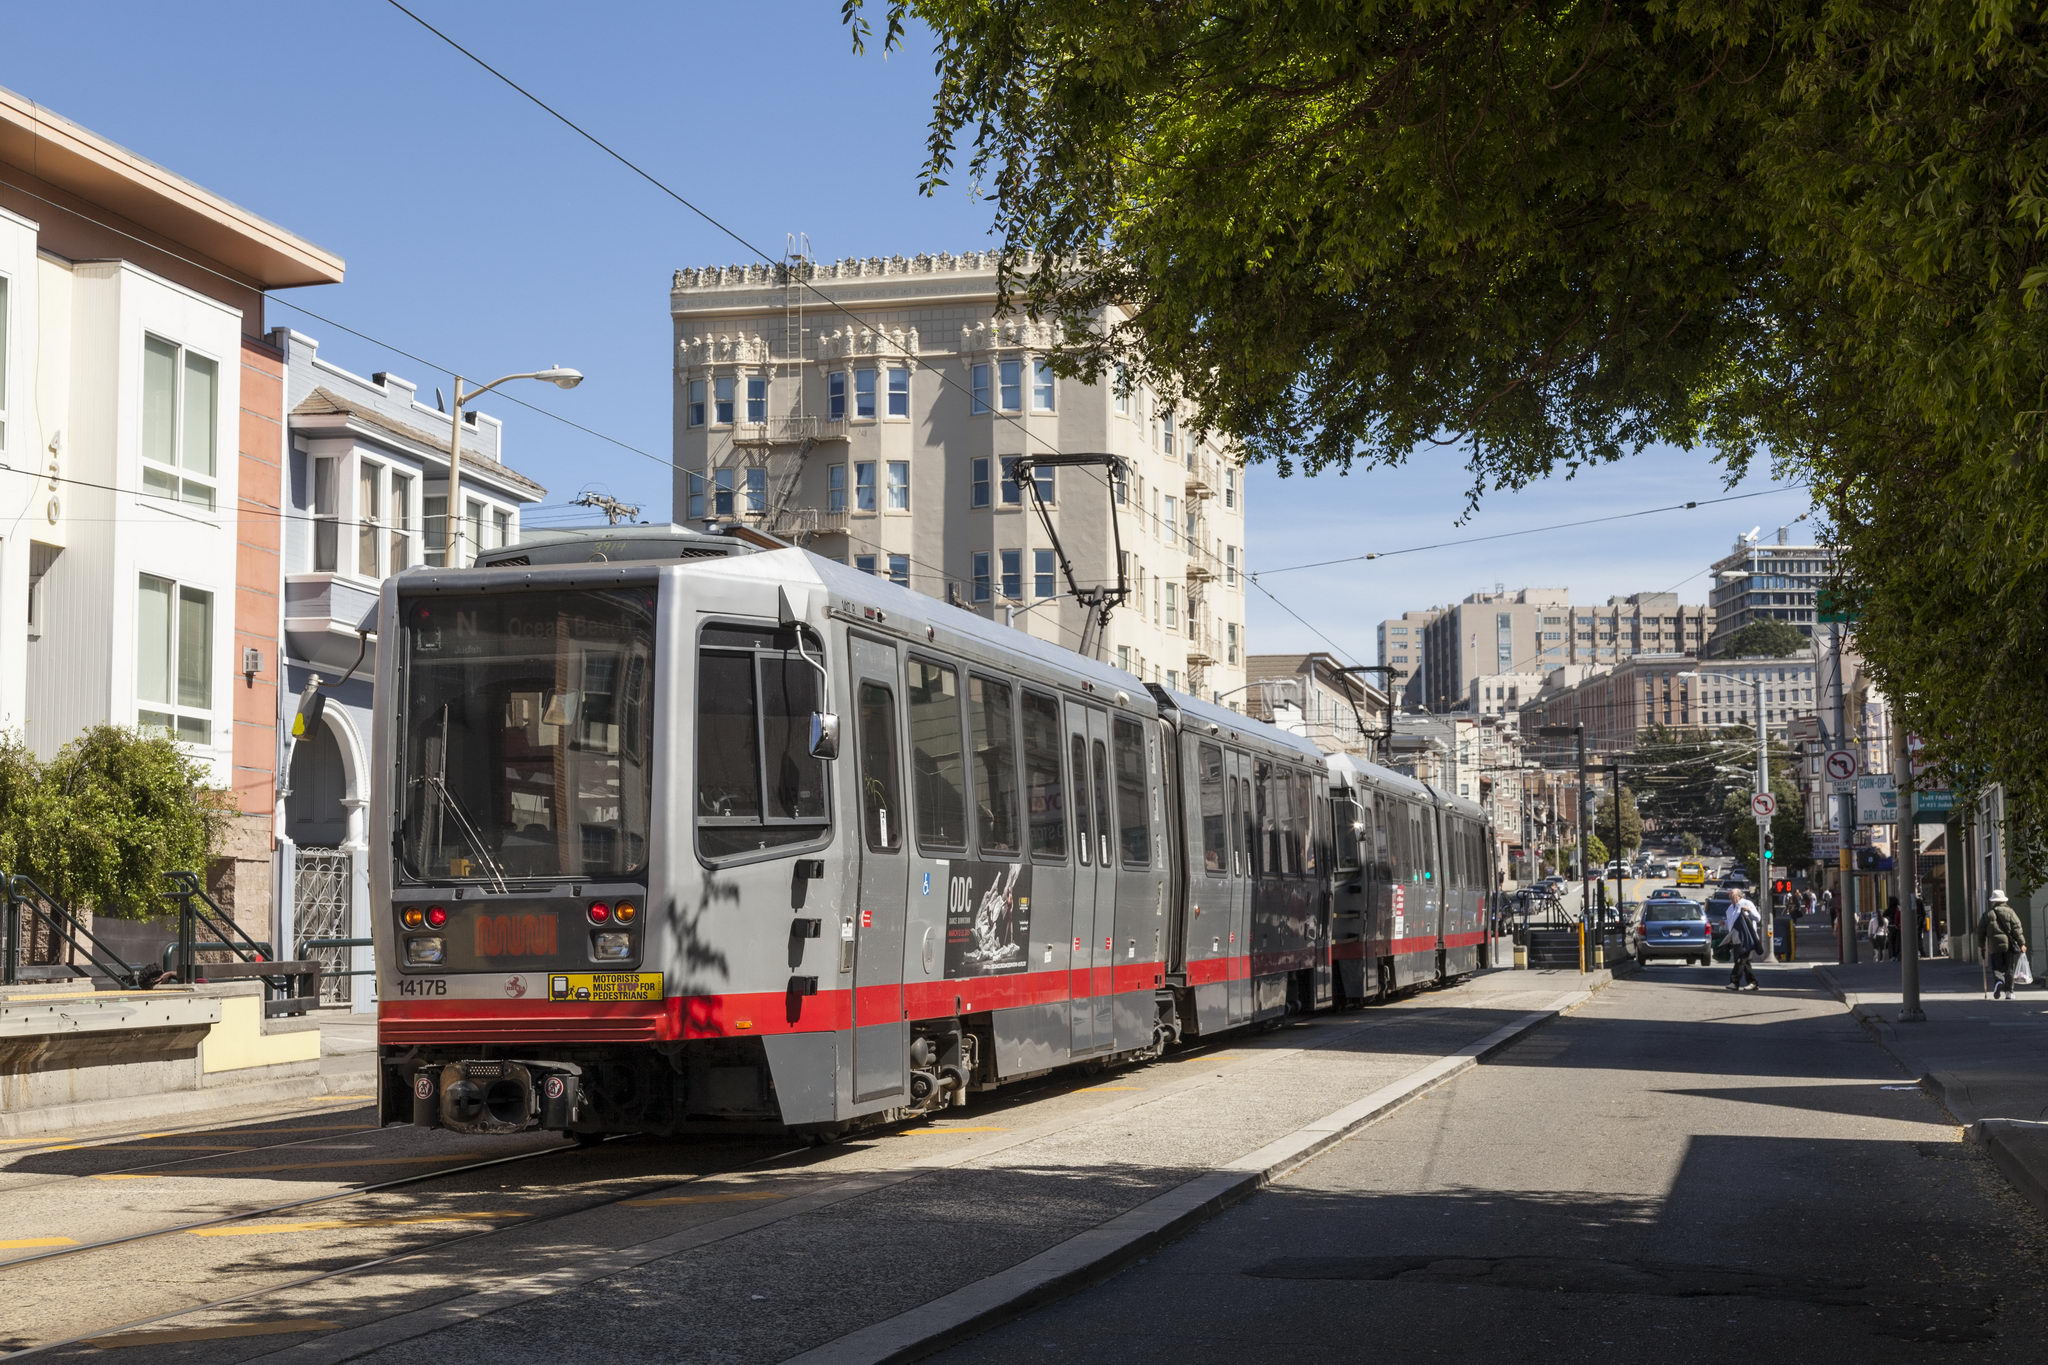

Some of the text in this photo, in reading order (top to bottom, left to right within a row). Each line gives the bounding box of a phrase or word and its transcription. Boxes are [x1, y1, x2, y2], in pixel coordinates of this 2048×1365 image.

[47, 430, 61, 526] 430
[456, 610, 478, 637] N
[508, 616, 557, 639] Ocea
[1859, 778, 1887, 790] COIN-OP
[1863, 809, 1878, 821] DRY
[949, 876, 972, 913] ODC
[592, 975, 640, 983] MOTORISTS
[396, 979, 448, 996] 1417B
[592, 982, 656, 992] MUST STOP FOR
[592, 991, 648, 1000] PEDESTRIANS
